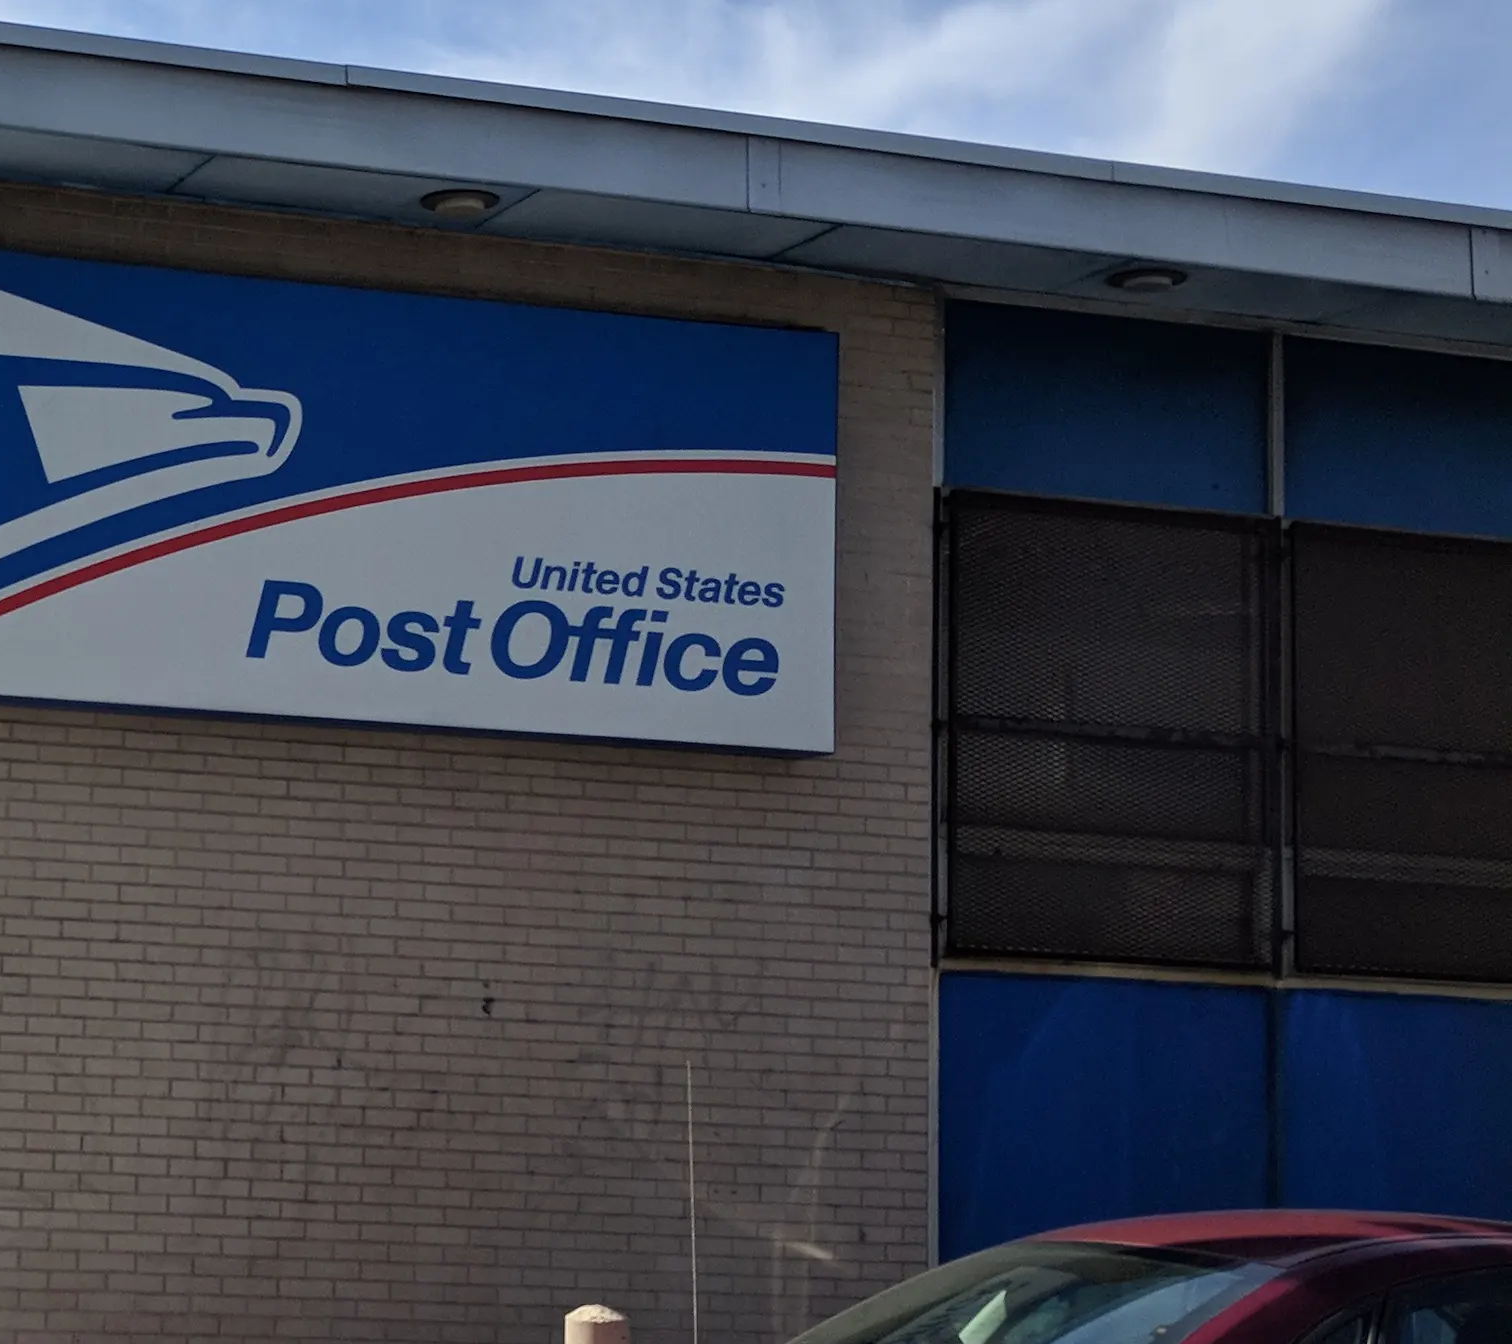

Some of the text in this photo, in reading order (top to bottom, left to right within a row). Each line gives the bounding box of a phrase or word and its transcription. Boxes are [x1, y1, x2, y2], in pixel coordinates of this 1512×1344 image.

[511, 556, 786, 609] United States
[245, 579, 781, 697] Post Office
